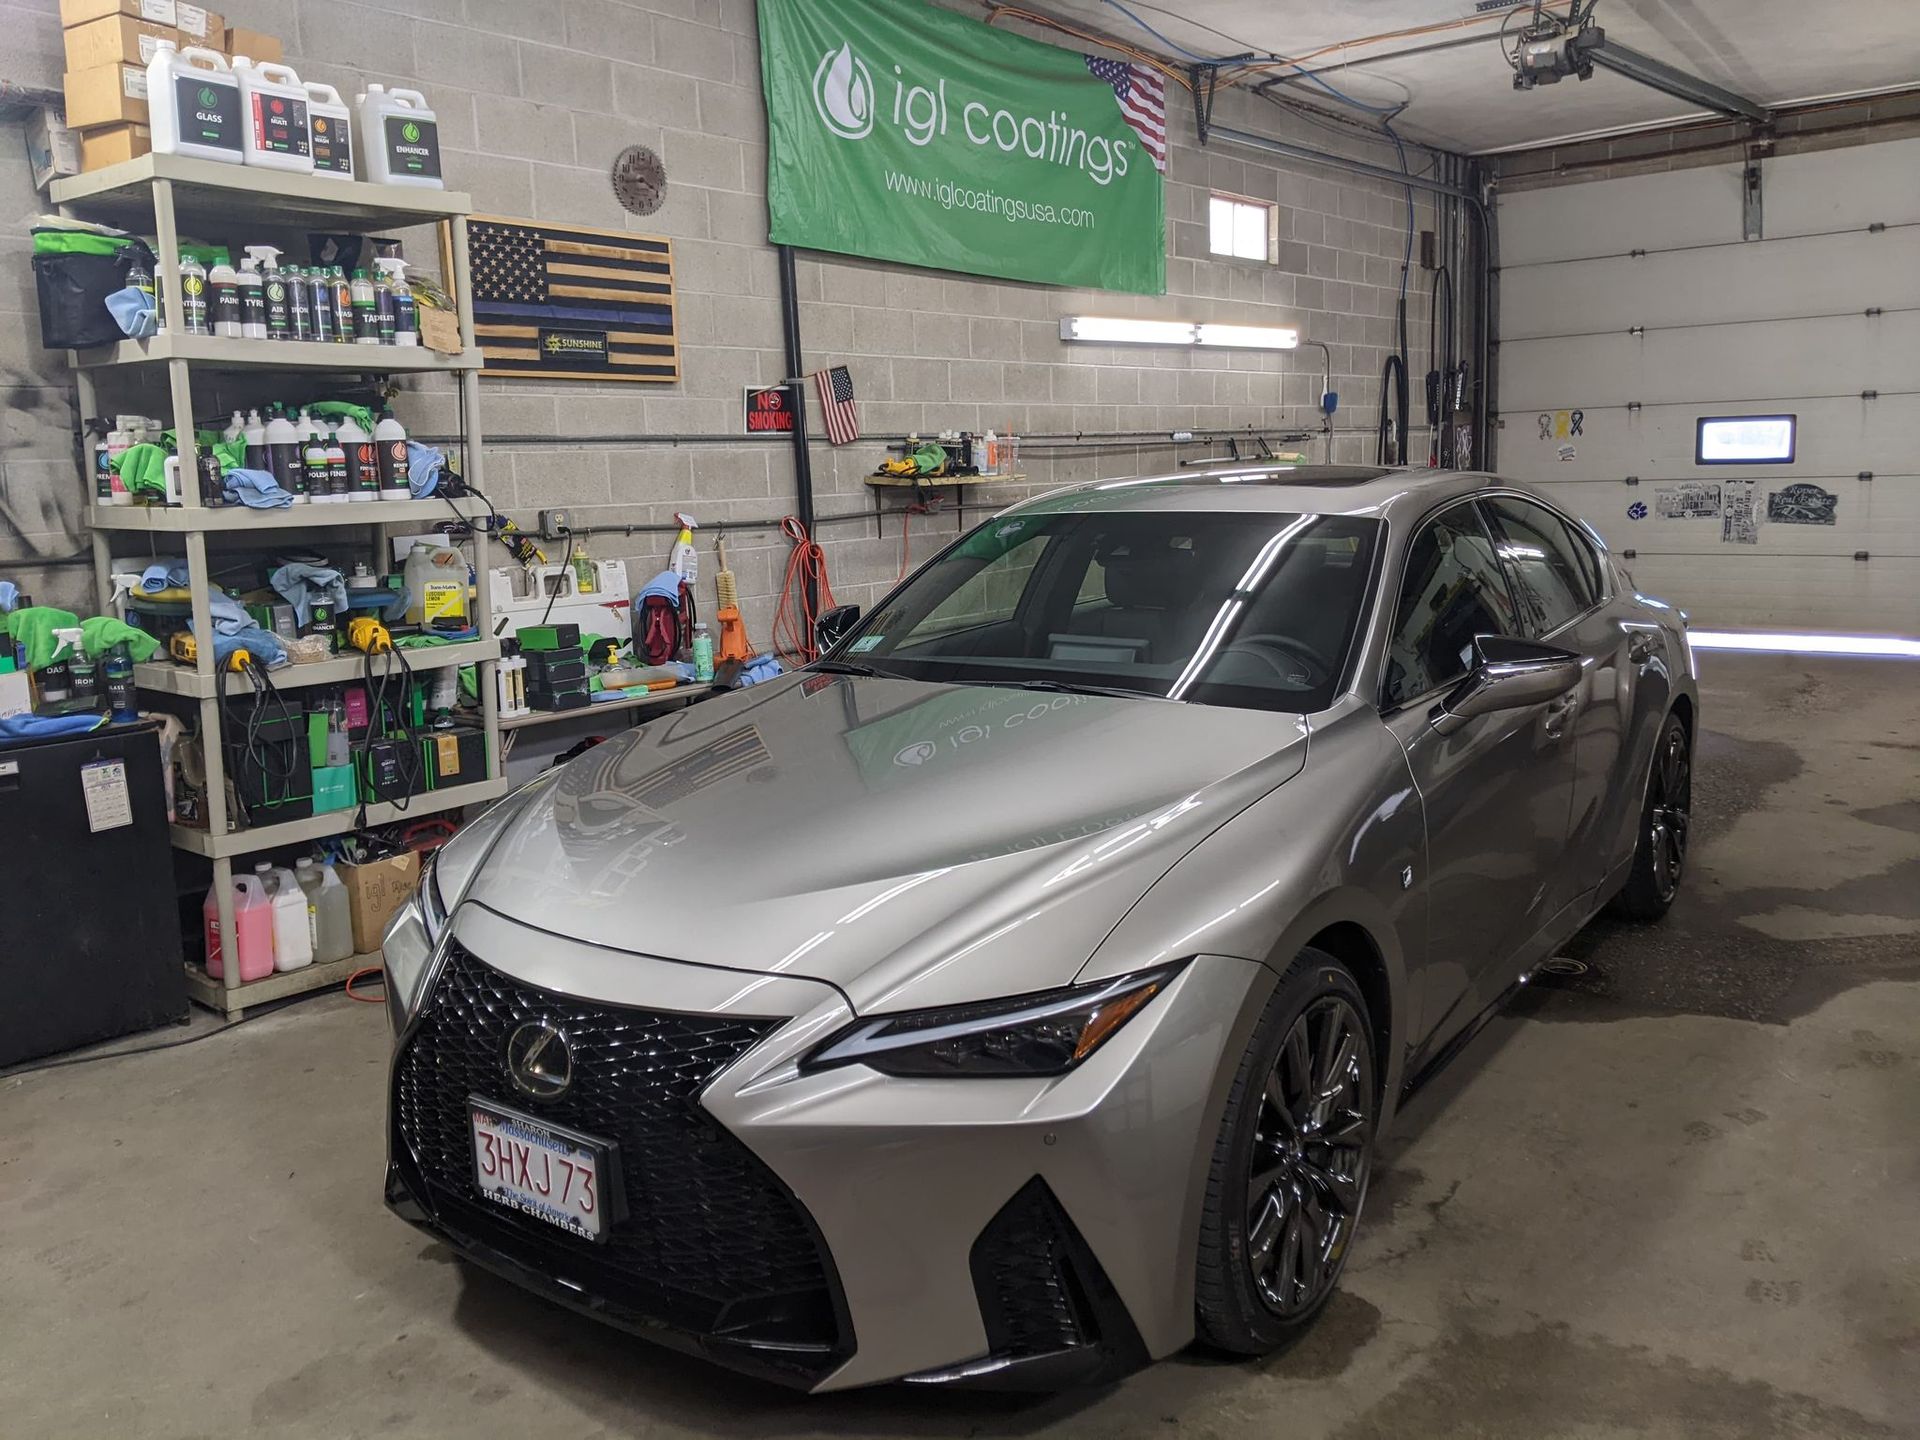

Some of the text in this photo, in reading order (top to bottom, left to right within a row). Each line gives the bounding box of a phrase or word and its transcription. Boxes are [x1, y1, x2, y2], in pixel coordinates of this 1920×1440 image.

[196, 111, 223, 124] GLASS
[893, 63, 948, 146] igl
[962, 101, 1128, 186] coatings
[396, 145, 430, 157] ENHANCER
[884, 169, 1095, 230] www.iglcoatingsusa.com
[182, 300, 207, 308] NTERIO
[561, 338, 603, 350] SUNSHINE
[757, 392, 781, 410] NO
[748, 411, 793, 430] SMOKING
[329, 470, 347, 478] FINIS
[511, 1119, 551, 1139] SHARON
[482, 1188, 595, 1241] HERB CHAMBERS
